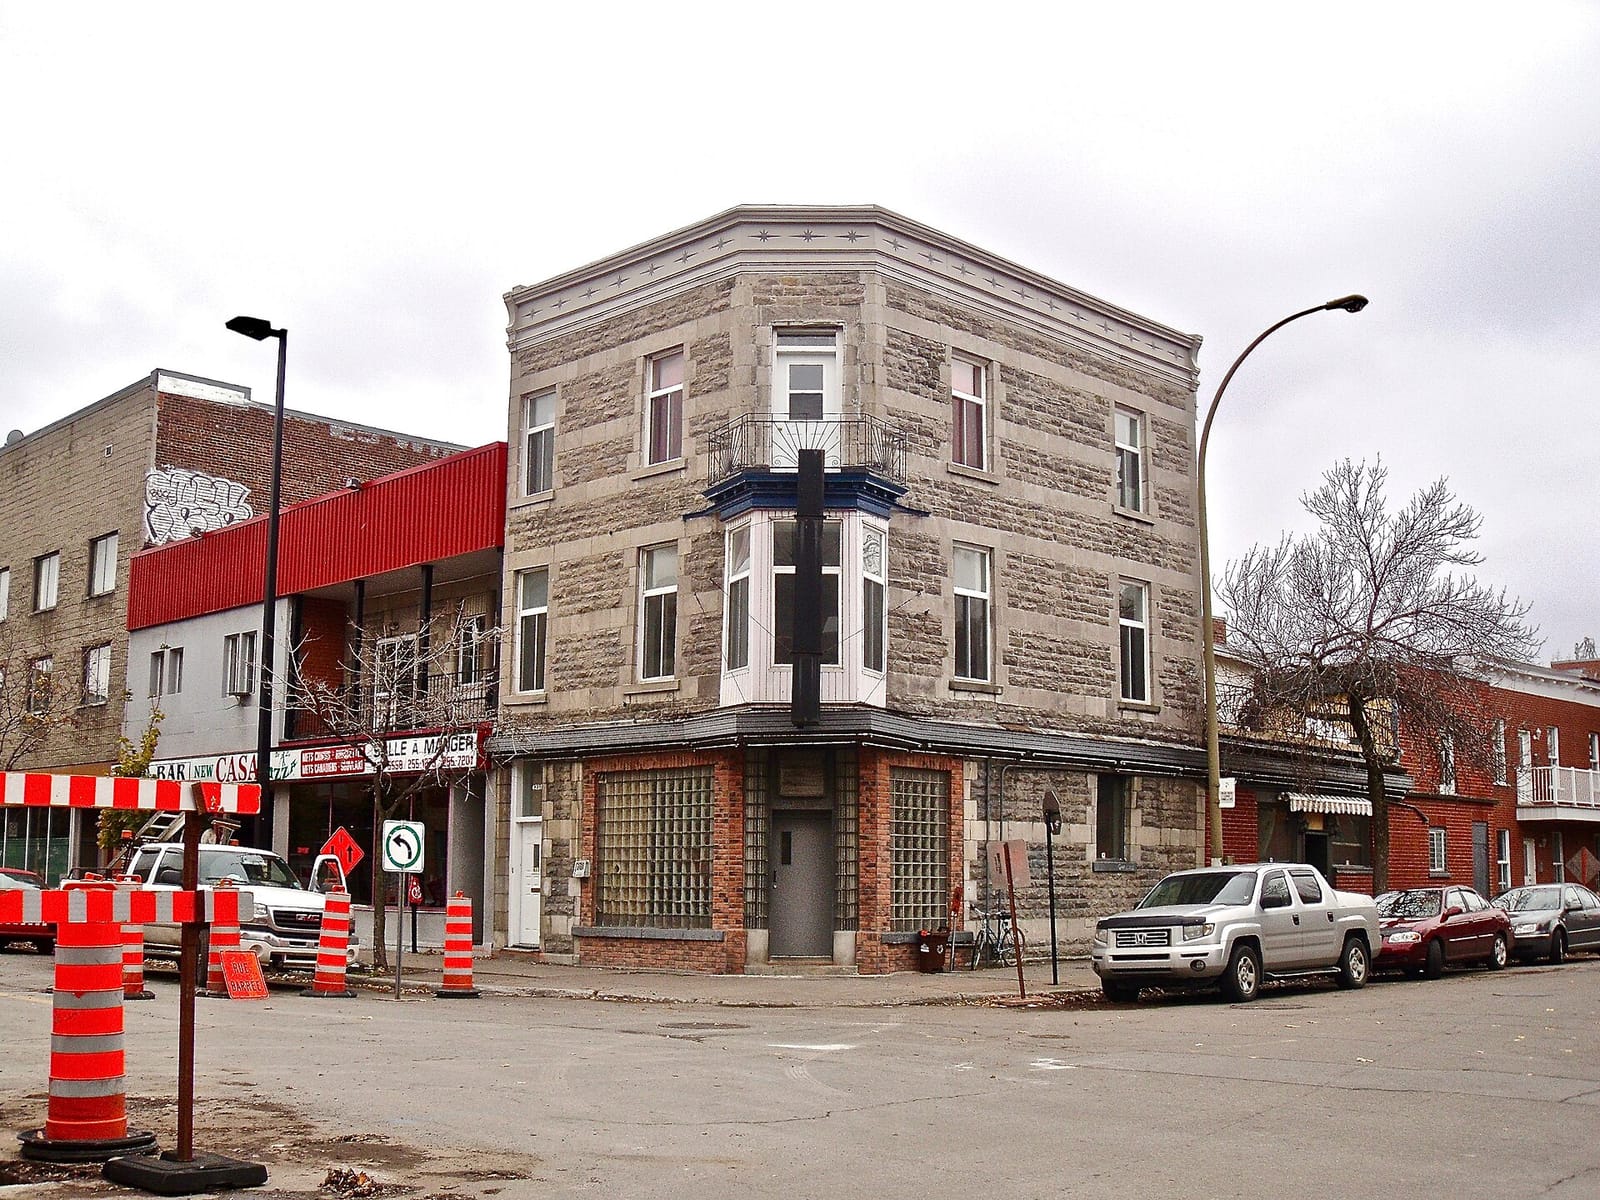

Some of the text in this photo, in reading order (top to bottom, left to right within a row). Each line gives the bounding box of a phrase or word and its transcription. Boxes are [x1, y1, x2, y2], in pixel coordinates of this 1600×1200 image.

[373, 741, 407, 758] SLLE
[424, 735, 474, 754] MANGER
[156, 754, 259, 782] BAR NEW CASA
[295, 913, 320, 922] GMC
[232, 962, 250, 974] RUE
